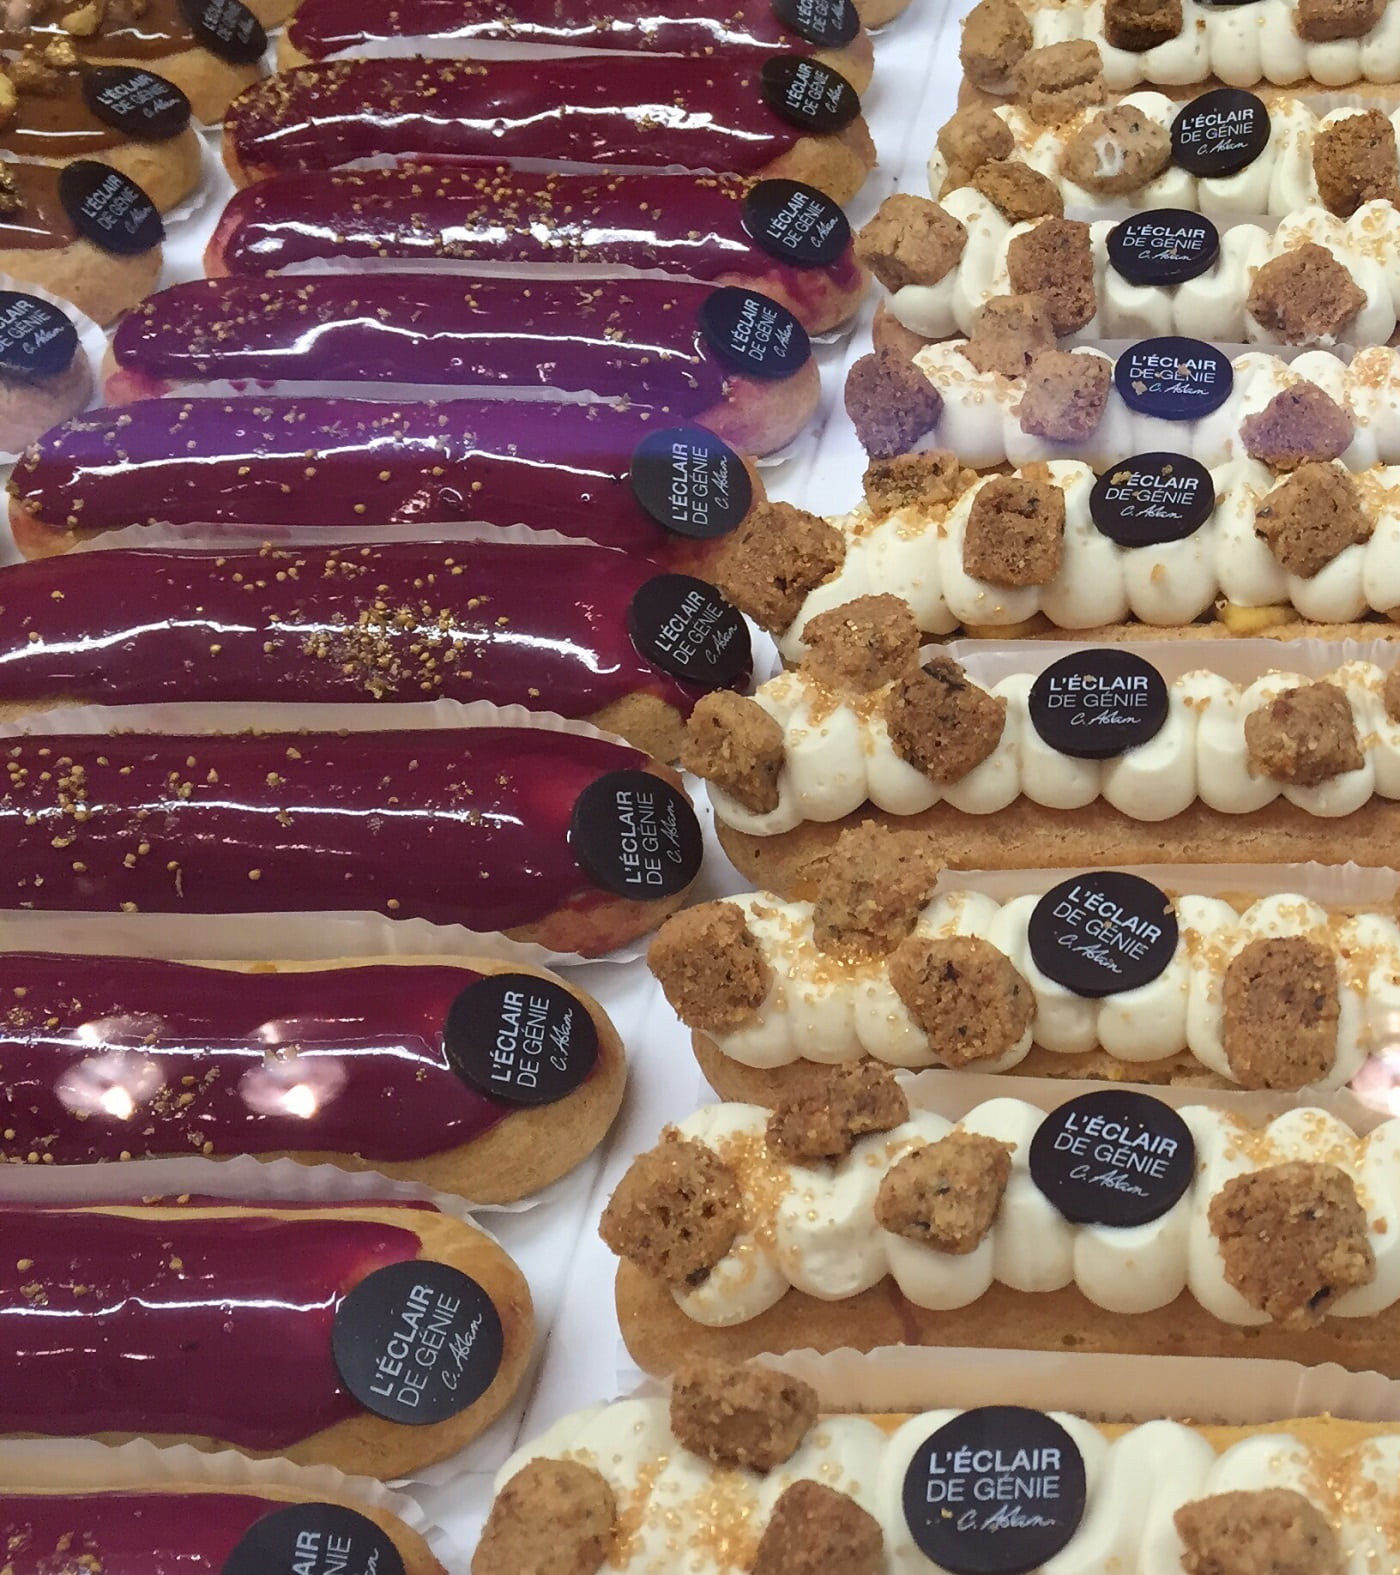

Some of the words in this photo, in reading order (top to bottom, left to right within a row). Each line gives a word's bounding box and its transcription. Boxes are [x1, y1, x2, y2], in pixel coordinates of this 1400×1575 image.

[803, 99, 817, 115] DE
[1182, 108, 1254, 131] L'ÉCLAIR
[1181, 130, 1202, 144] DE
[1206, 124, 1253, 139] GÉNIE
[766, 192, 810, 239] L'ÉCLAIR
[782, 231, 802, 249] DE
[795, 201, 825, 233] GÉNIE
[1123, 237, 1147, 247] DE
[1150, 236, 1203, 250] GÉNIE
[1125, 225, 1205, 239] L'ÉCLAIR
[731, 299, 760, 352] L'ÉCLAIR
[754, 307, 778, 345] GÉNIE
[749, 342, 766, 361] DE
[1130, 368, 1155, 380] DE
[668, 443, 688, 521] L'ÉCLAIR
[689, 446, 708, 497] GÉNIE
[1105, 489, 1133, 501] DE
[1136, 488, 1195, 505] GÉNIE
[692, 501, 708, 525] DE
[655, 591, 706, 651] L'ÉCLAIR
[673, 640, 696, 664] DE
[1050, 674, 1149, 691] L'ÉCLAIR
[1048, 693, 1076, 707] DE
[1083, 690, 1148, 707] GÉNIE
[616, 791, 642, 884] L'ÉCLAIR
[637, 793, 660, 852] GÉNIE
[646, 857, 663, 886] DE
[1052, 901, 1086, 927] DE
[1068, 886, 1162, 944] L'ÉCLAIR
[490, 991, 524, 1082] L'ÉCLAIR
[521, 996, 550, 1055] GÉNIE
[516, 1059, 539, 1088] DE
[1064, 1112, 1178, 1157] L'ÉCLAIR
[1053, 1132, 1090, 1157] DE
[1094, 1143, 1171, 1179] GÉNIE
[370, 1284, 434, 1397] L'ÉCLAIR
[397, 1371, 428, 1408] DE
[414, 1294, 461, 1369] GÉNIE
[929, 1445, 1062, 1474] L'ÉCLAIR
[926, 1478, 966, 1503] DE
[973, 1472, 1061, 1501] GÉNIE
